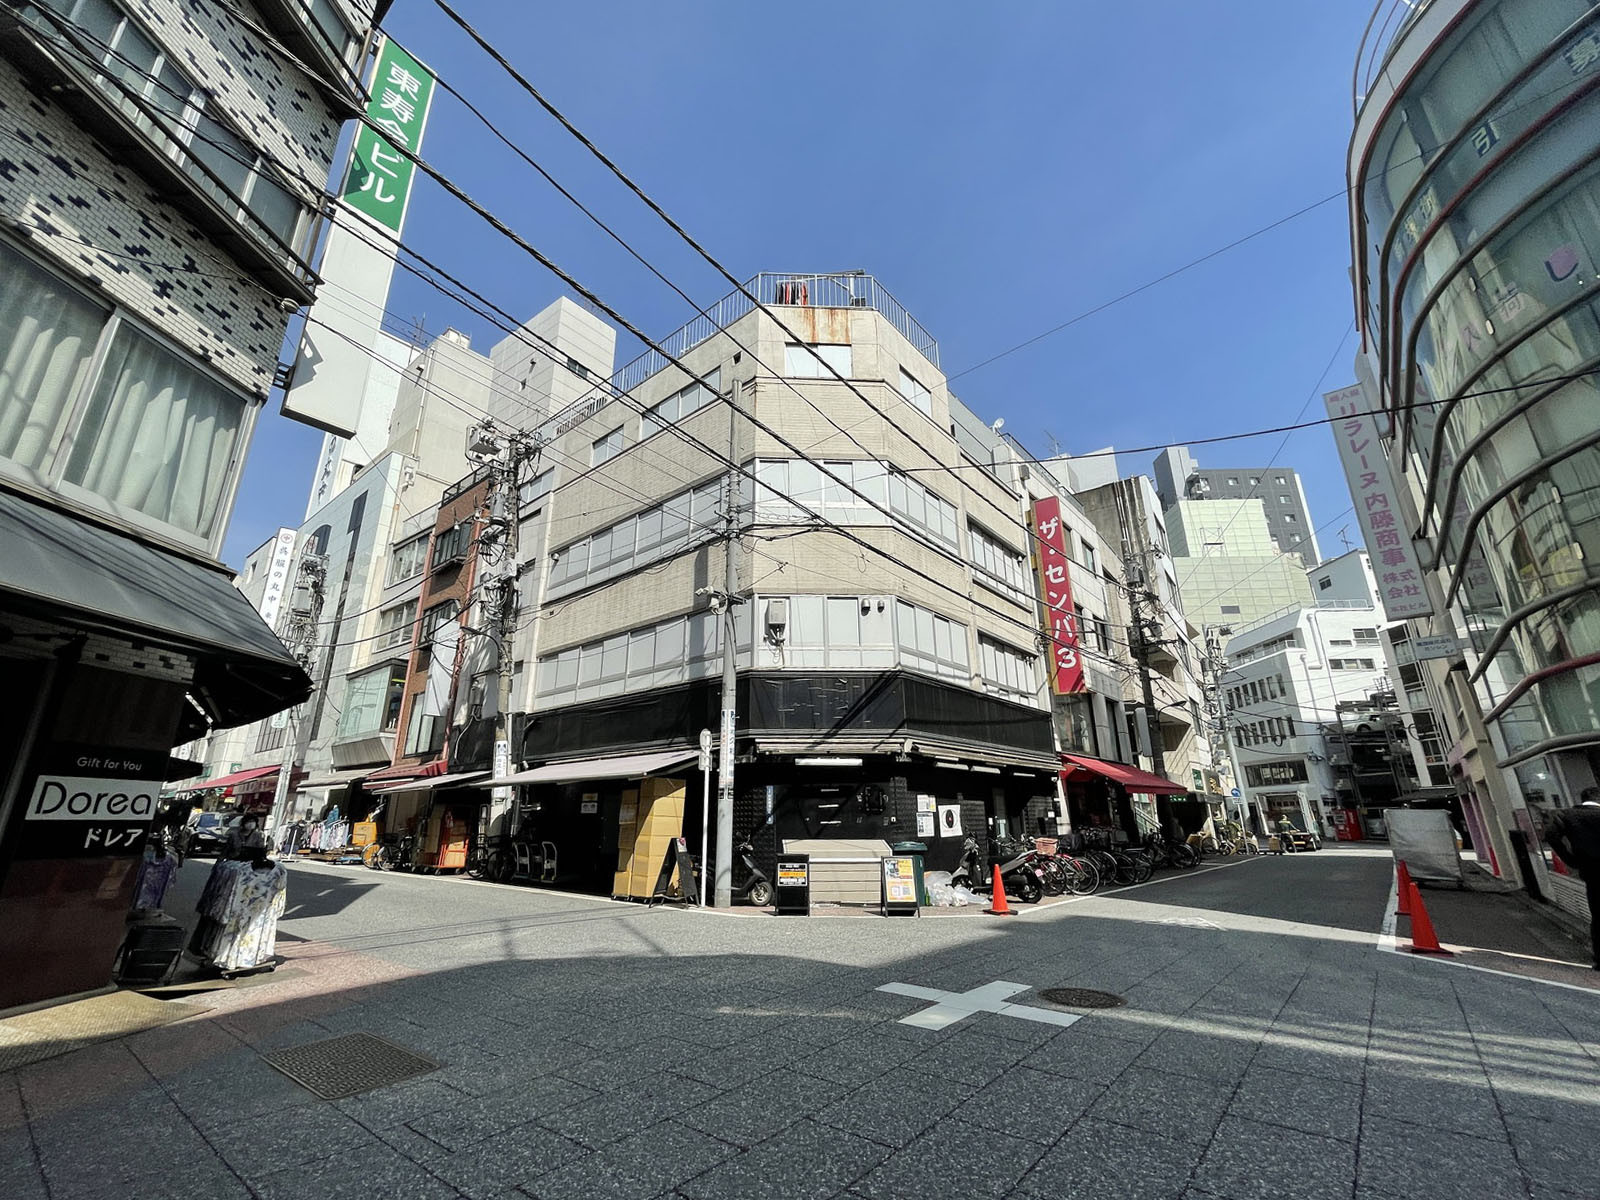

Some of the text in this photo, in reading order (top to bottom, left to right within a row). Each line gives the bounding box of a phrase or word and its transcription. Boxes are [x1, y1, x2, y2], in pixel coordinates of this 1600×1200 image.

[1340, 402, 1407, 567] リラレーヌ 内藤商事
[77, 757, 143, 771] Gift for You
[34, 781, 153, 815] Dorea
[84, 828, 144, 849] ドレア
